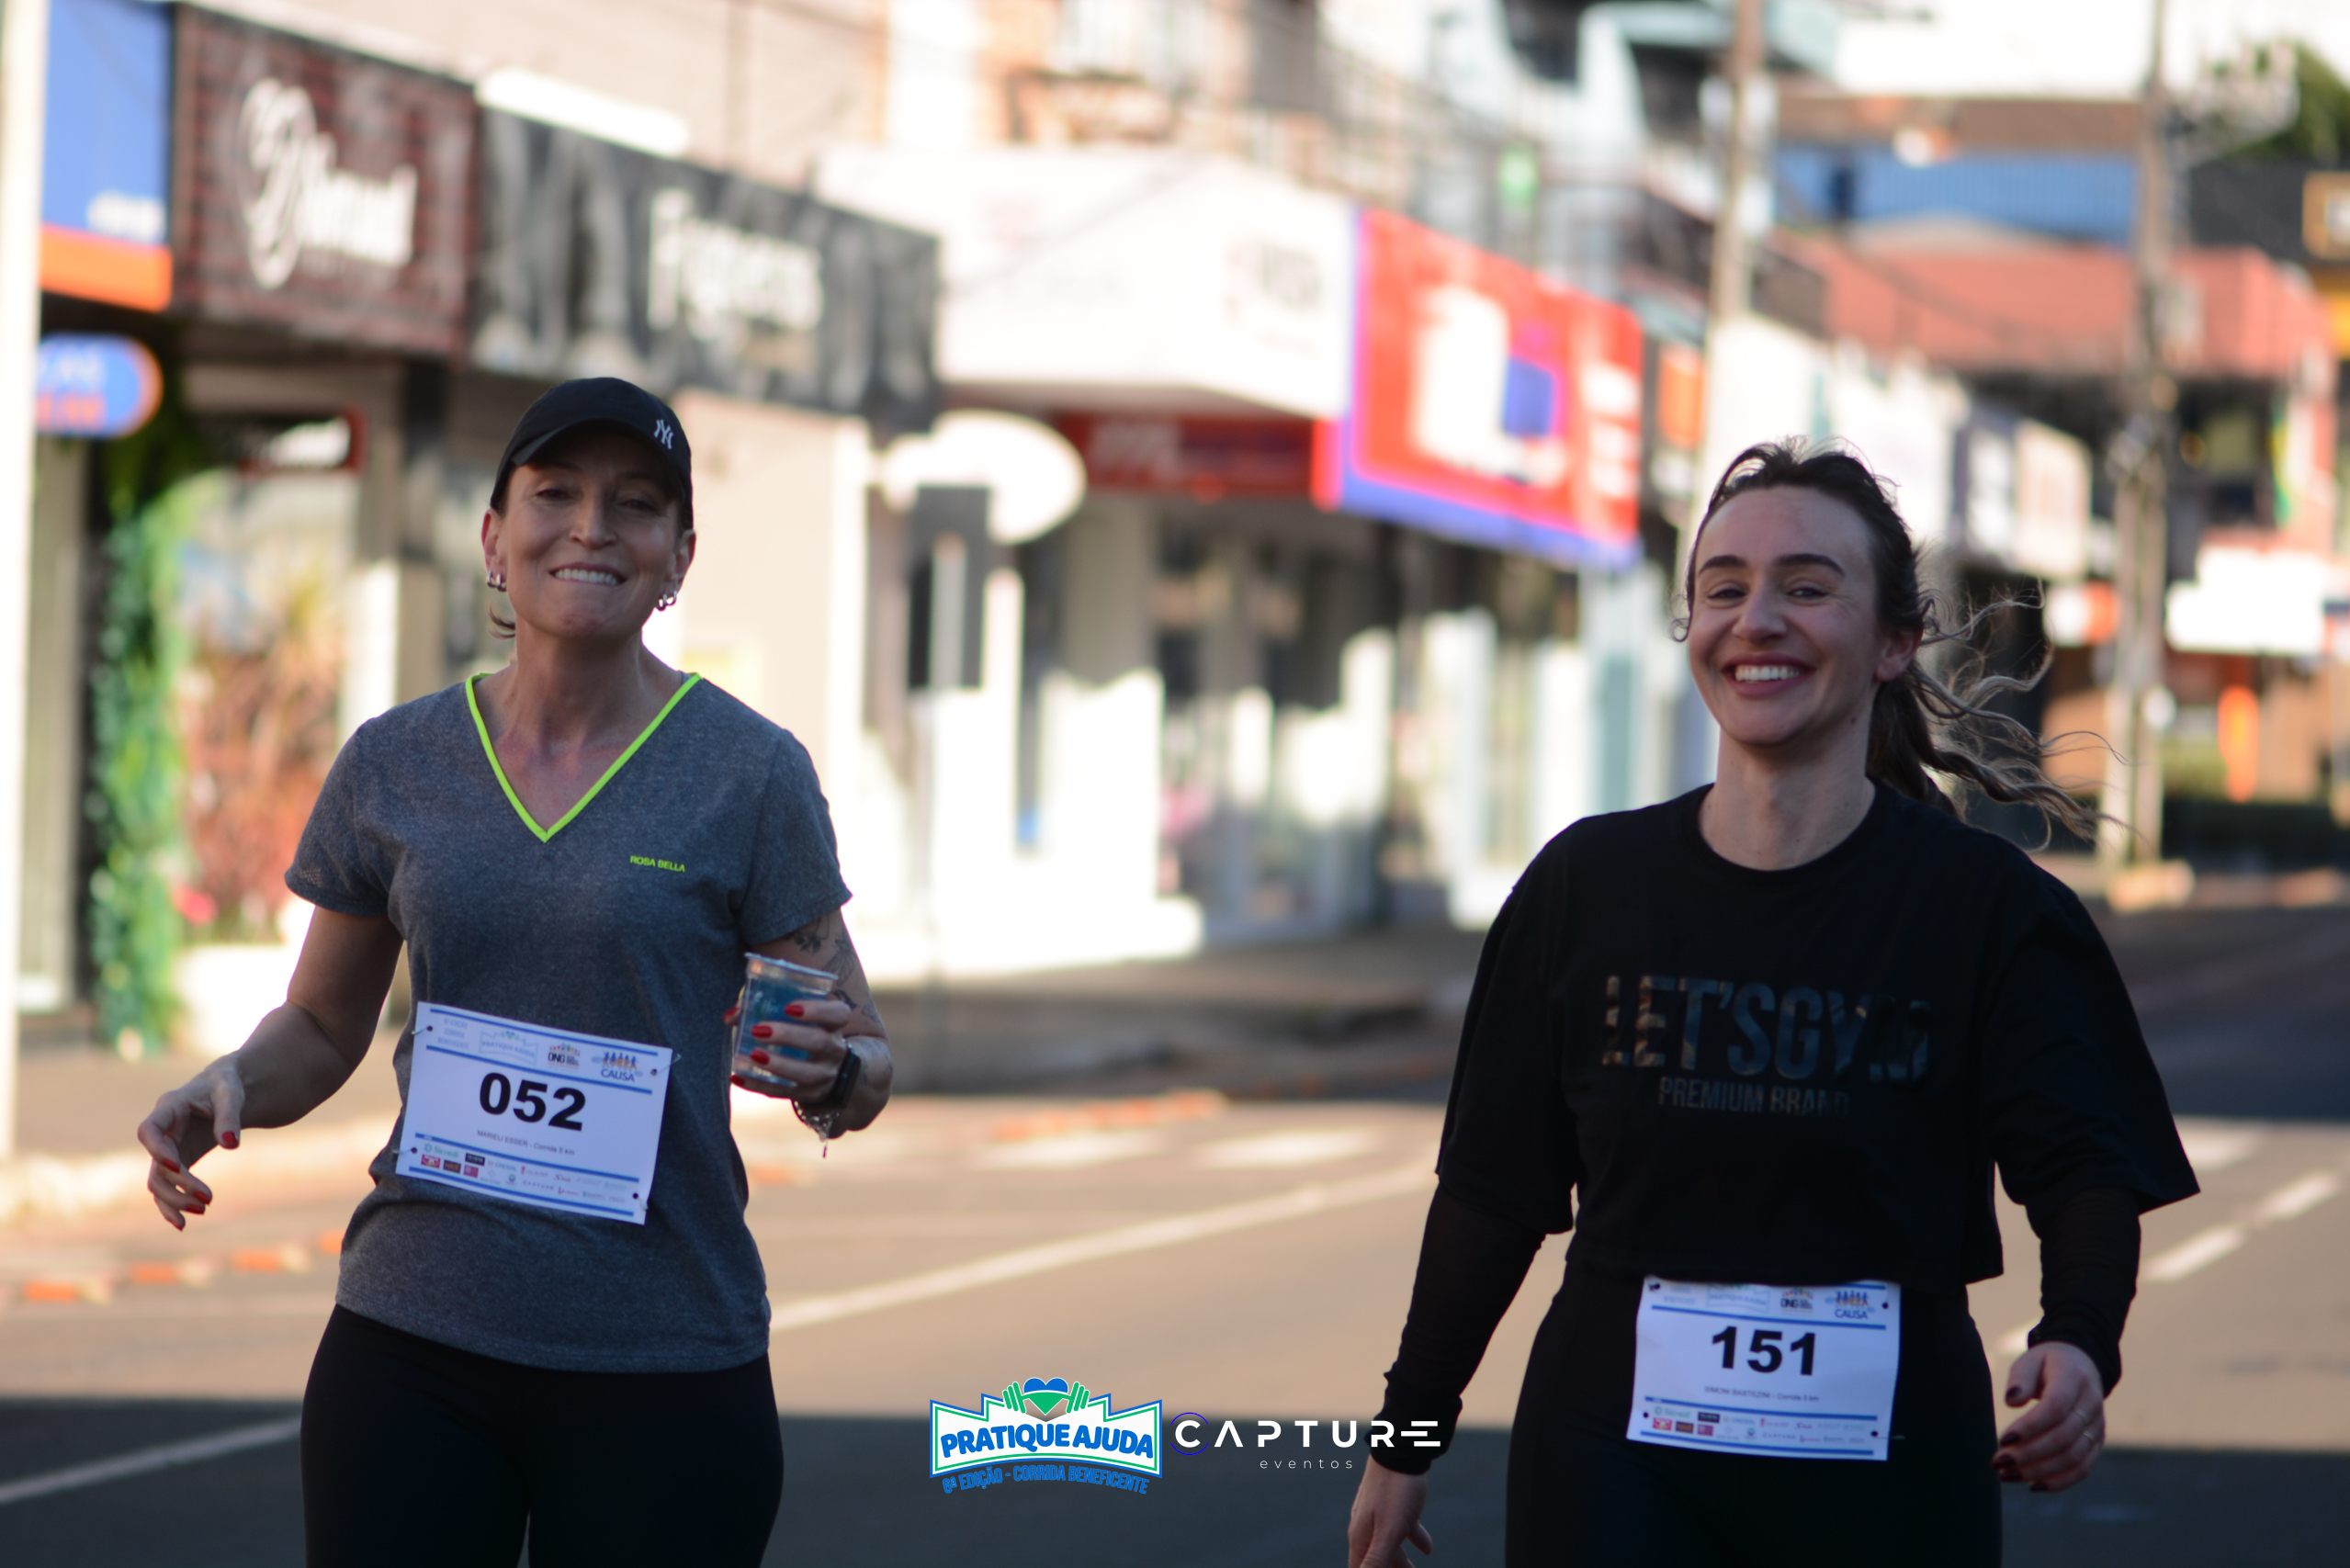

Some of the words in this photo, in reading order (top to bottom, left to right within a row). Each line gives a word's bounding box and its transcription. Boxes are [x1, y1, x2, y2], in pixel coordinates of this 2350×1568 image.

[653, 419, 673, 449] NY
[629, 855, 656, 867] ROSA
[658, 859, 685, 873] BELLA
[601, 1068, 635, 1083] CAUSA
[480, 1072, 586, 1132] 052
[1658, 1076, 1764, 1114] PREMIUM
[477, 1130, 503, 1142] MARIELI
[505, 1136, 528, 1147] ESSER
[534, 1143, 557, 1153] Corrida
[1835, 1309, 1868, 1319] CAUSA
[1712, 1325, 1815, 1376] 151
